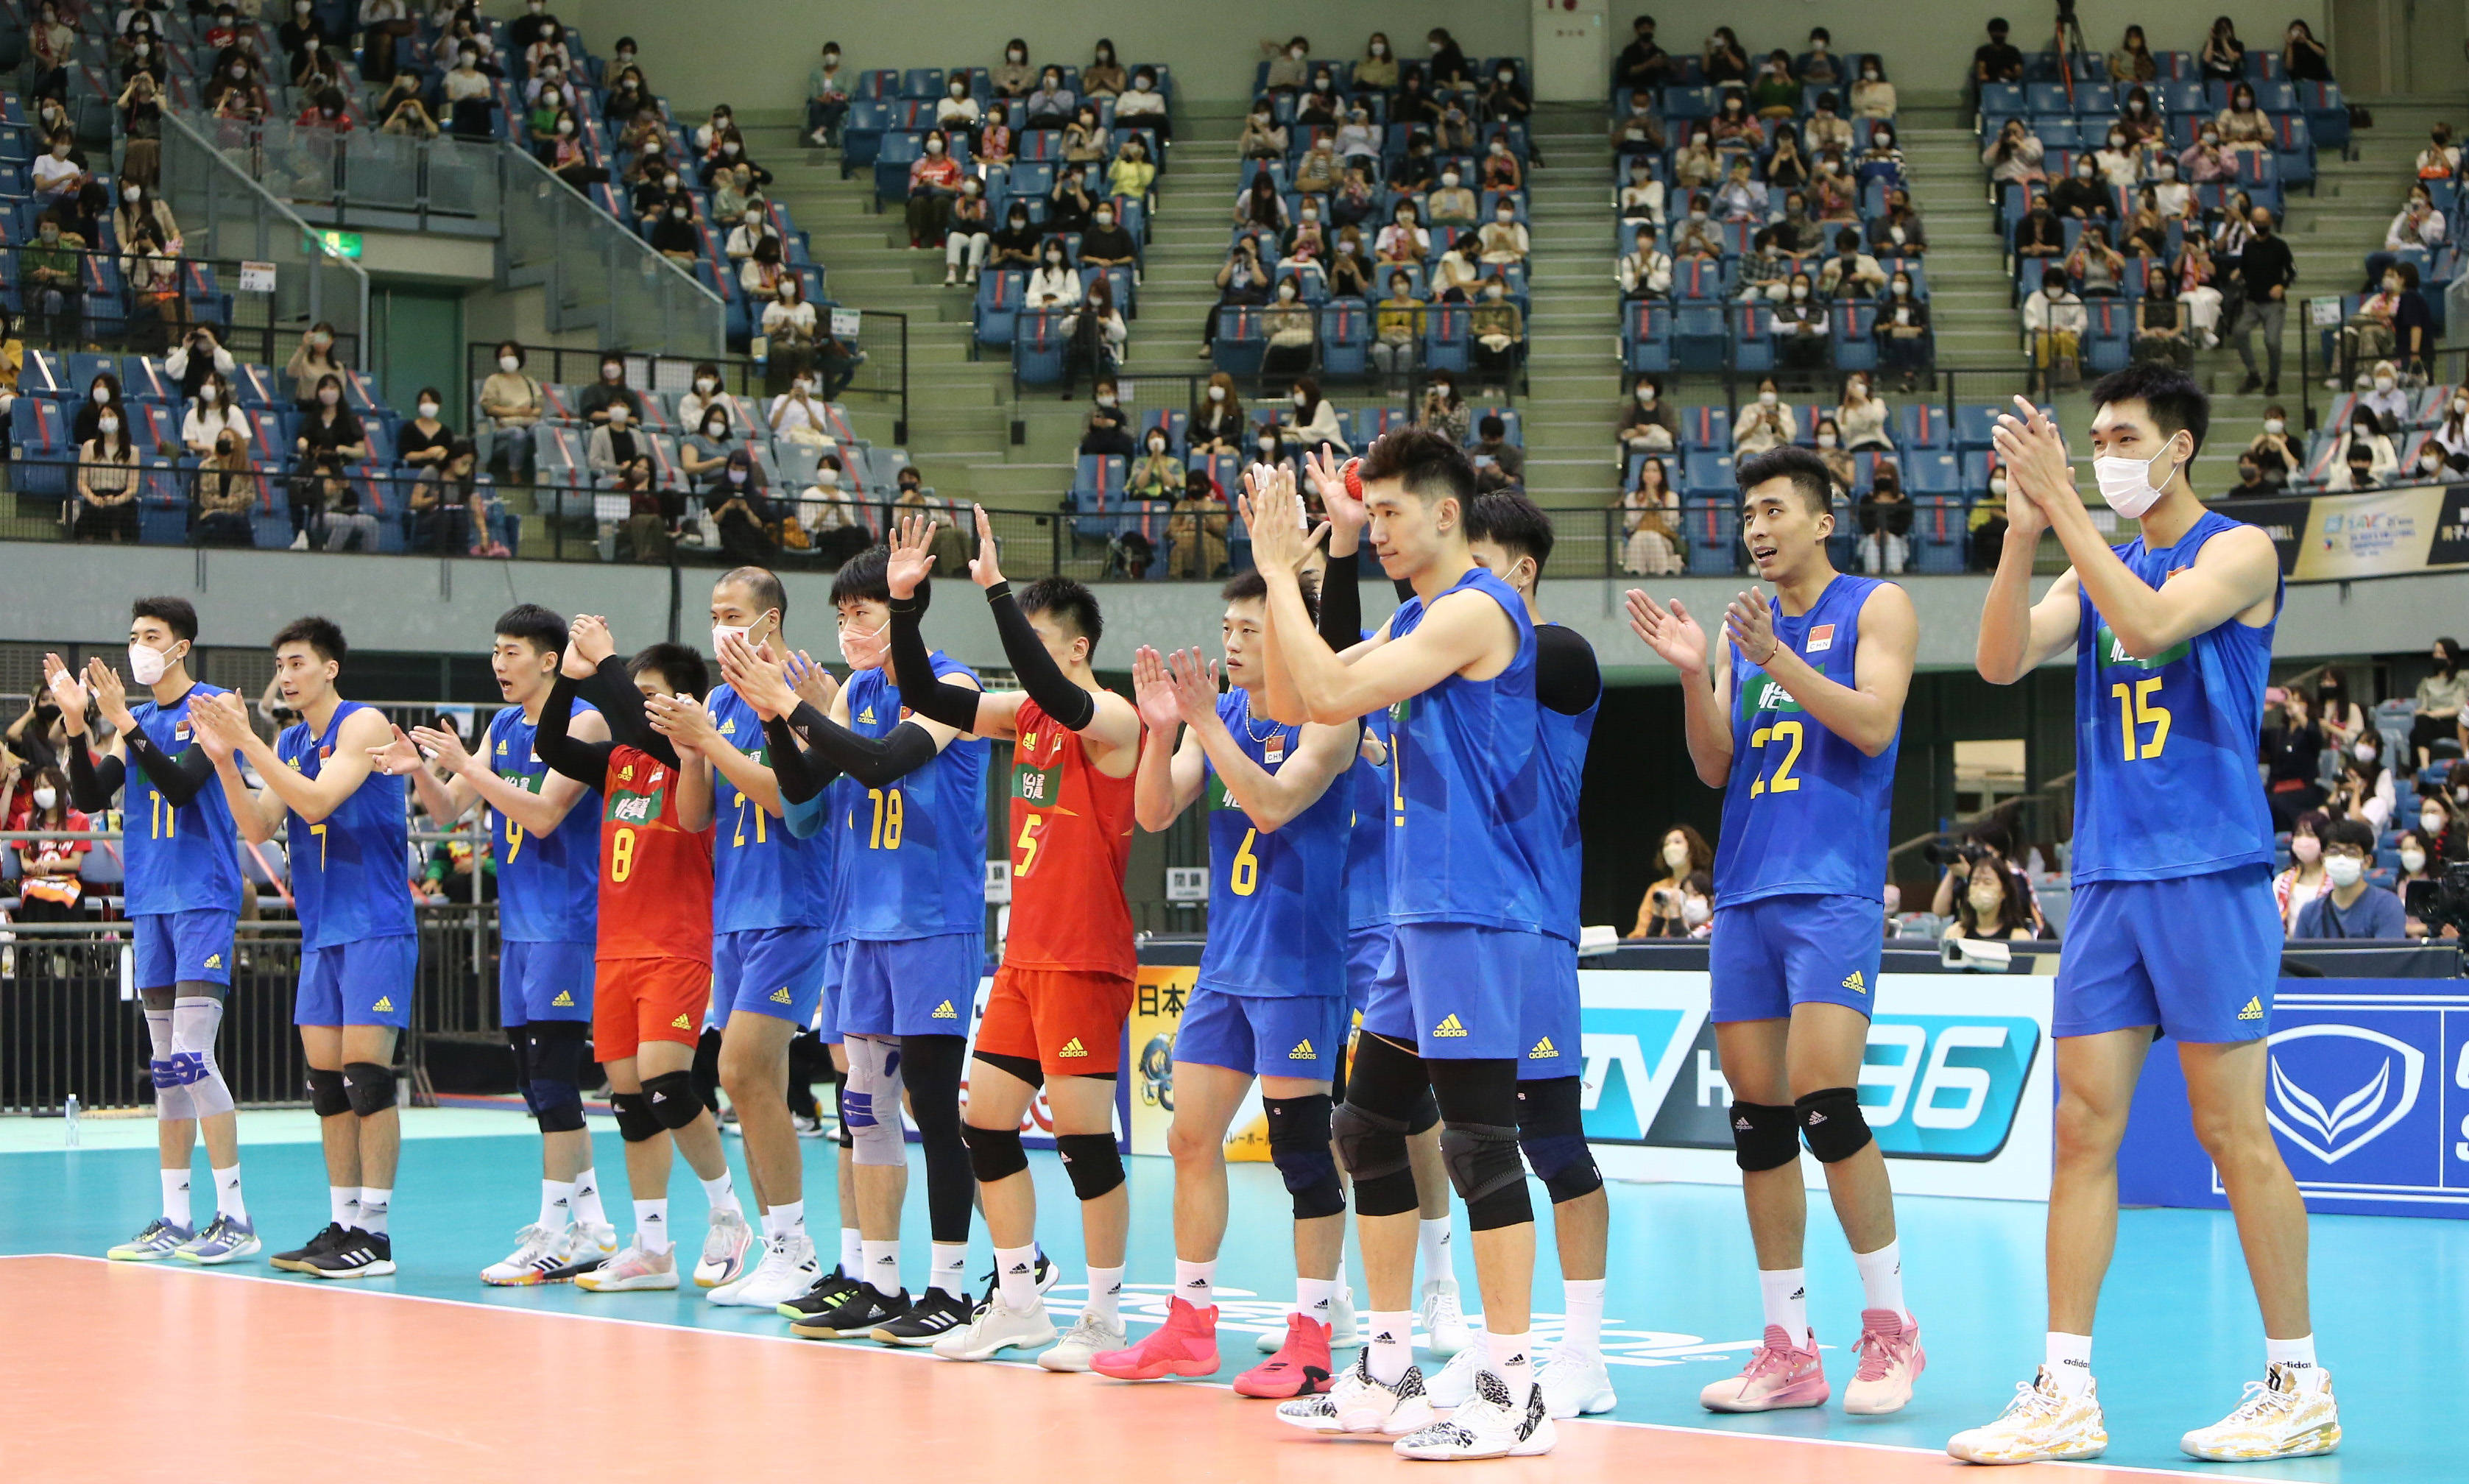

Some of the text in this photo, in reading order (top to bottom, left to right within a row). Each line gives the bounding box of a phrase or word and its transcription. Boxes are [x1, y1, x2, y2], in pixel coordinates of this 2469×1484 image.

[1809, 642, 1829, 650] CHN
[1758, 681, 1795, 710] 怡
[2111, 676, 2172, 761] 15
[1750, 721, 1804, 799] 22
[149, 790, 175, 840] 11
[733, 791, 766, 847] 21
[867, 788, 904, 849] 18
[309, 823, 328, 873] 7
[505, 816, 524, 864] 9
[611, 827, 636, 883] 8
[1014, 813, 1042, 877] 5
[1230, 827, 1258, 897] 6
[769, 995, 793, 1005] adidas
[1139, 983, 1195, 1017] 日本
[1842, 981, 1868, 995] adidas
[1432, 1030, 1469, 1038] adidas
[2238, 1011, 2264, 1020] adidas
[1059, 1050, 1089, 1058] adidas
[1528, 1050, 1560, 1059] adidas
[1857, 1024, 2009, 1130] 36
